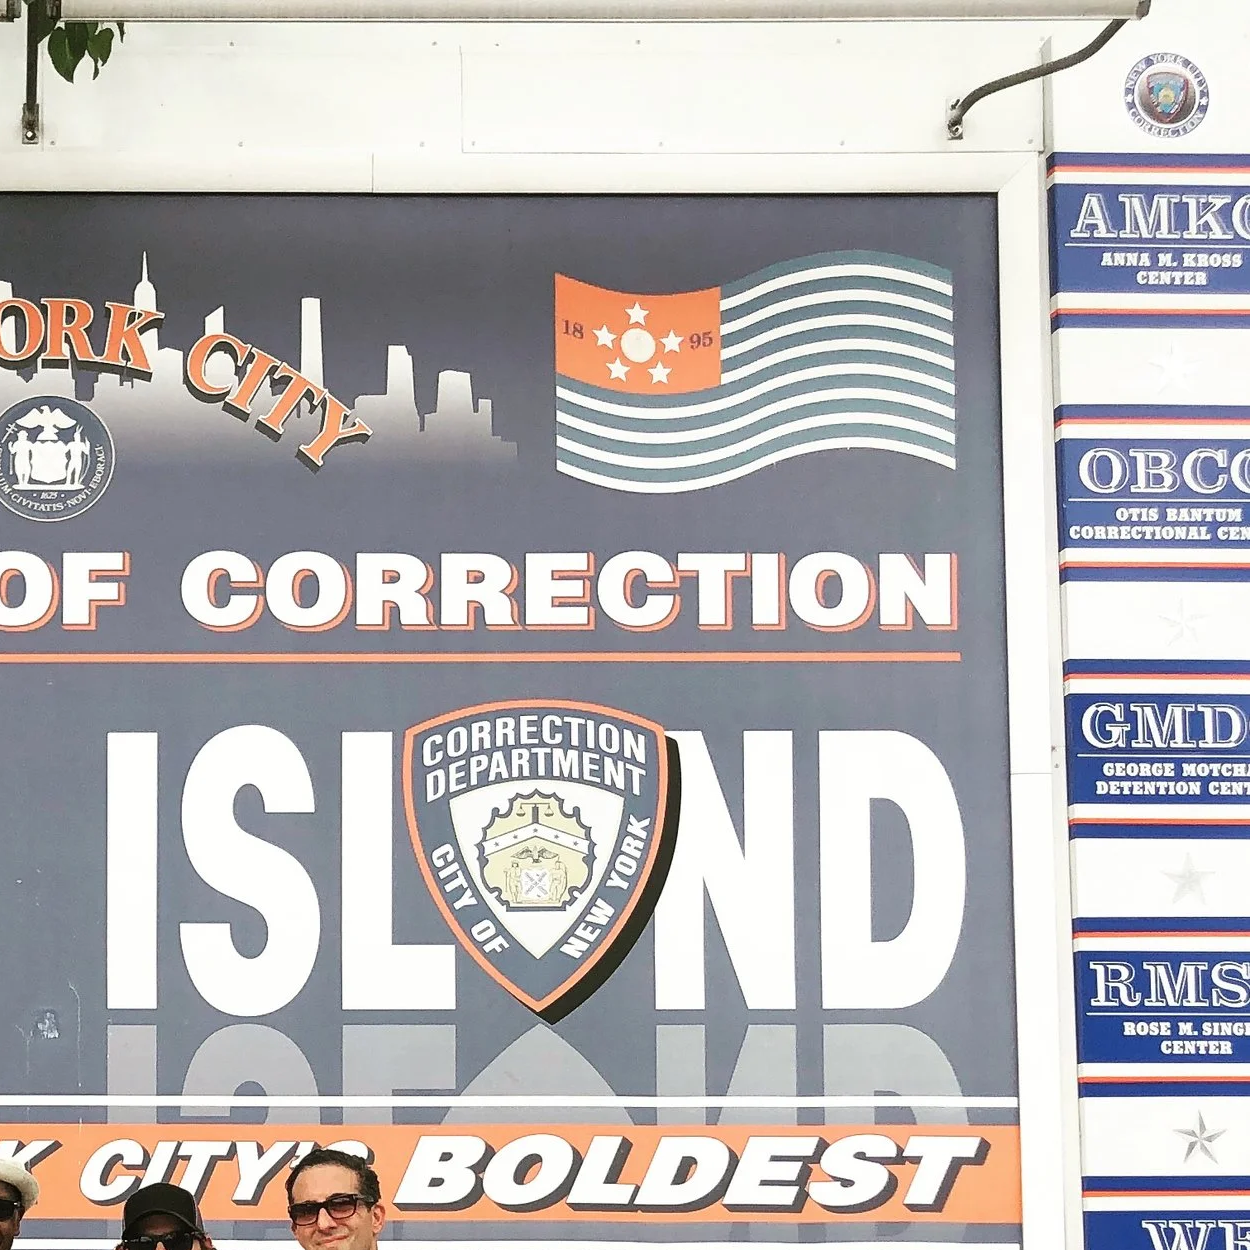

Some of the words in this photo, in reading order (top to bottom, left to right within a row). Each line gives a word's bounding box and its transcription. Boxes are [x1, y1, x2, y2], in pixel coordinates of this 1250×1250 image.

[1101, 252, 1150, 266] ANNA
[1158, 253, 1177, 267] M.
[1182, 253, 1243, 268] KROSS
[1136, 271, 1208, 285] CENTER
[562, 320, 584, 340] 18
[689, 331, 713, 350] 95
[185, 332, 372, 474] CITY
[67, 489, 91, 507] NOVI
[1116, 507, 1159, 522] OTIS
[1166, 508, 1242, 522] BANTUM
[1069, 526, 1211, 540] CORRECTIONAL
[180, 550, 958, 632] CORRECTION
[422, 715, 646, 768] CORRECTION
[426, 747, 646, 803] DEPARTMENT
[1103, 763, 1175, 777] GEORGE
[1096, 781, 1201, 795] DETENTION
[106, 724, 967, 1017] ISLND
[431, 843, 478, 911] CITY
[470, 918, 510, 954] OF
[559, 898, 616, 959] NEW
[605, 814, 651, 890] YORK
[1090, 961, 1250, 1008] RMS
[1123, 1021, 1171, 1036] ROSE
[1178, 1022, 1198, 1036] M.
[1160, 1040, 1233, 1055] CENTER
[392, 1133, 991, 1214] BOLDEST
